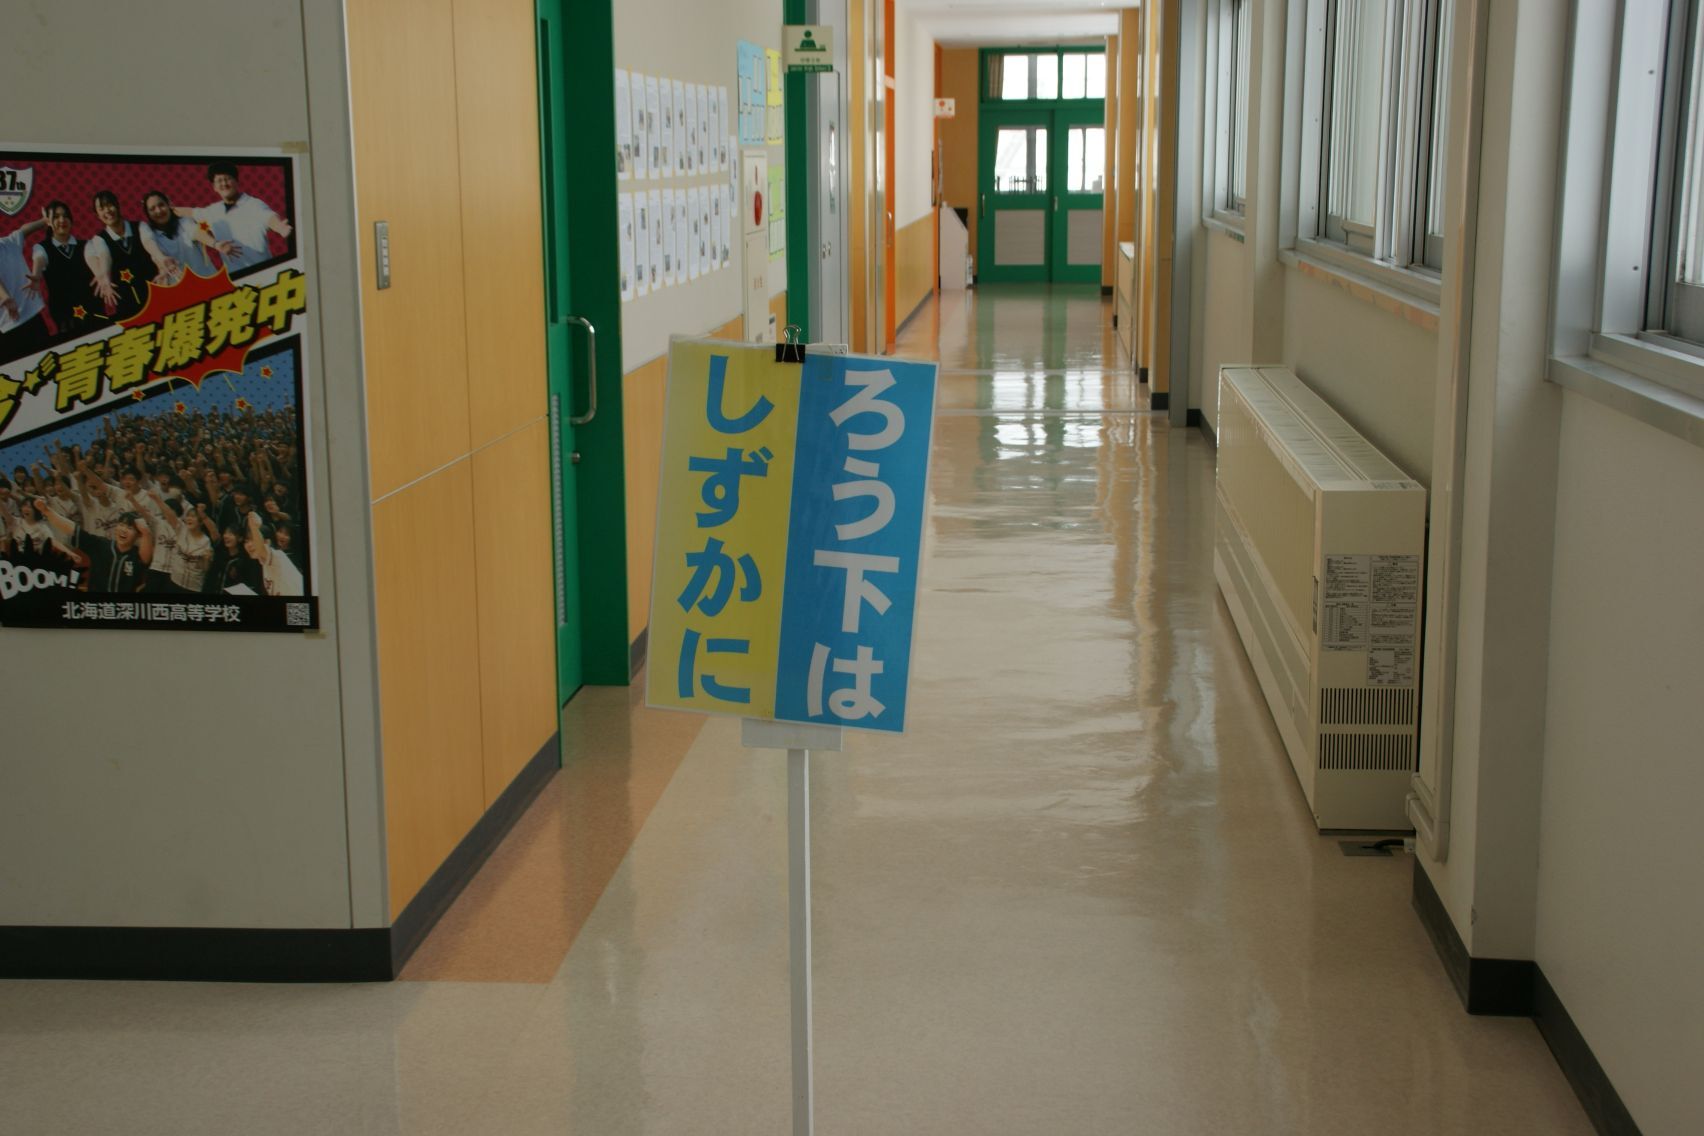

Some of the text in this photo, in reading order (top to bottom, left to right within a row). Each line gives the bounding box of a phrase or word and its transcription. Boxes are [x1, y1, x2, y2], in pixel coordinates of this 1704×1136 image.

[55, 270, 306, 412] 青春爆発中
[0, 560, 80, 600] BOOM!
[677, 354, 775, 704] しずかに
[807, 368, 906, 720] ろう下は
[62, 601, 241, 623] 北海道深川西高等学校
